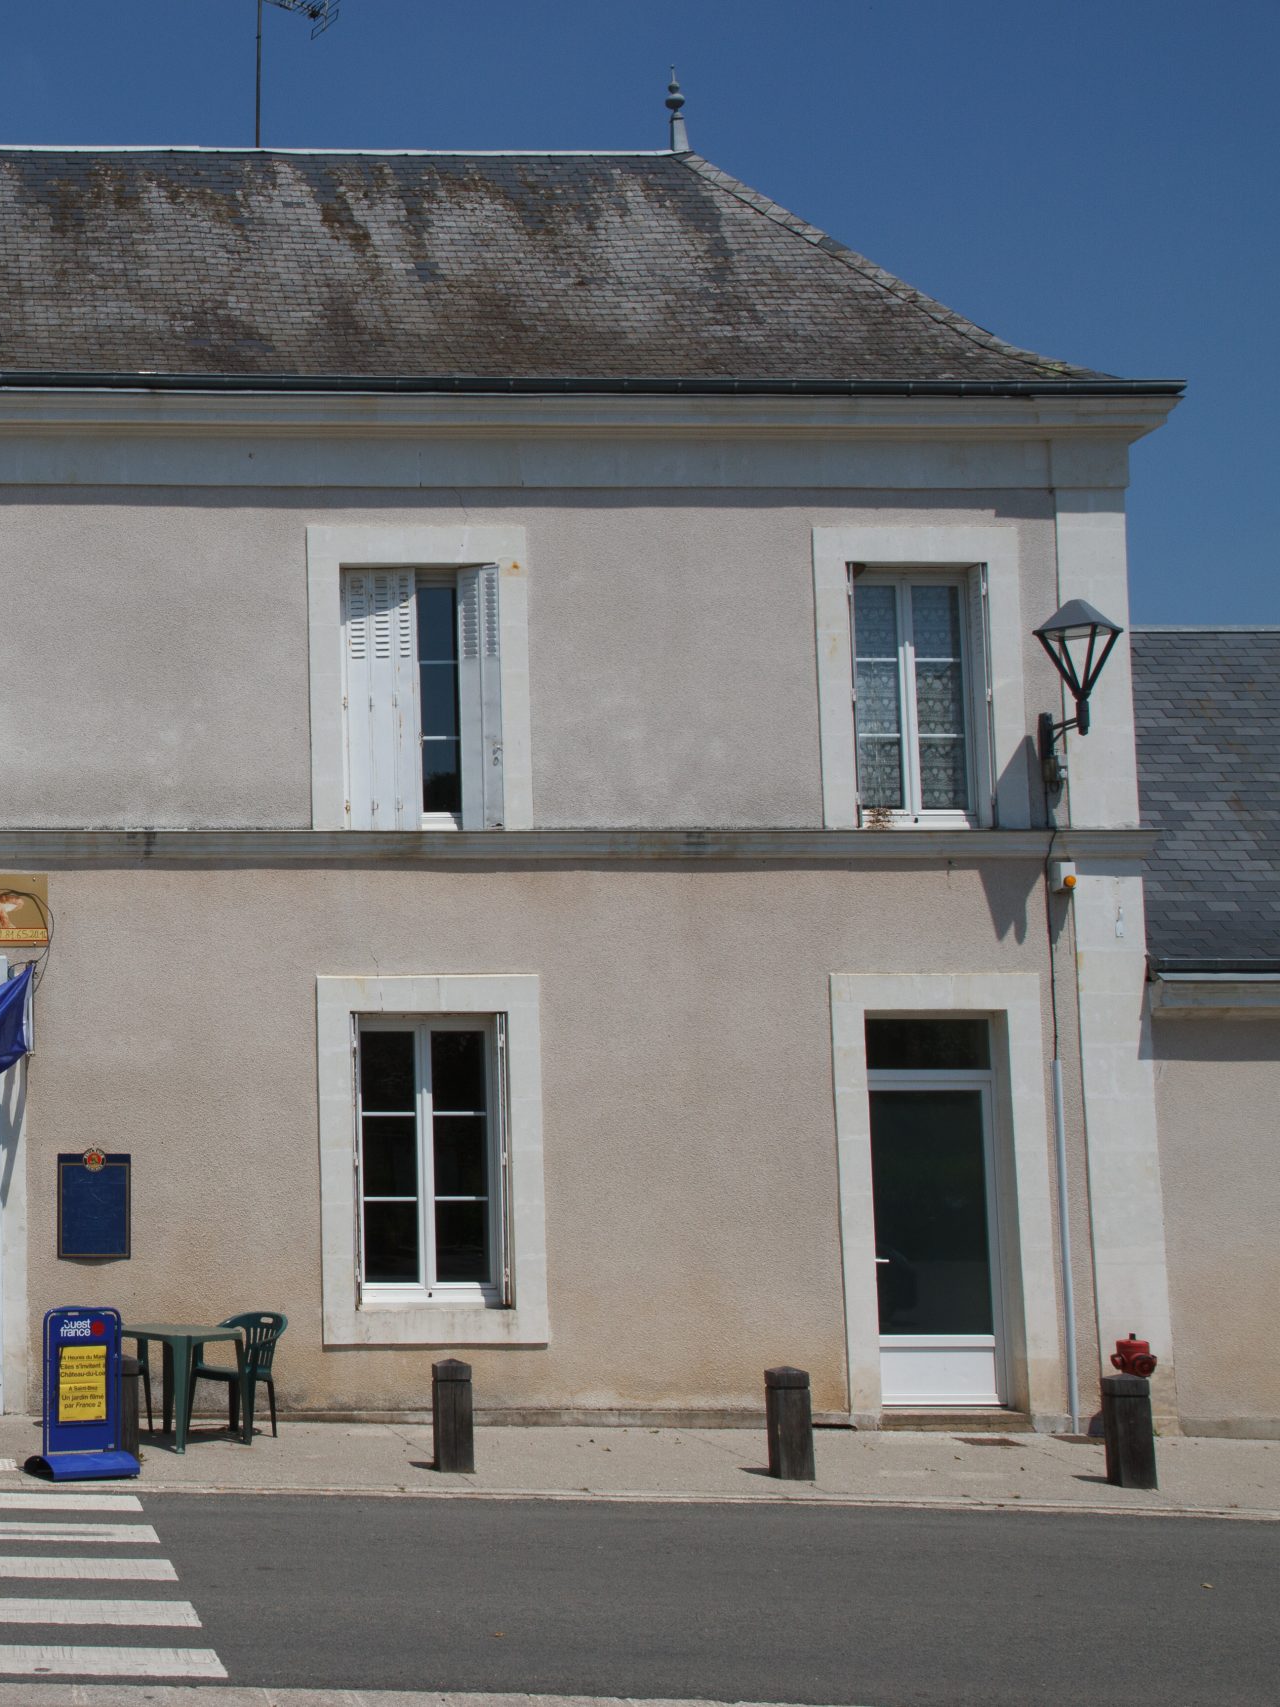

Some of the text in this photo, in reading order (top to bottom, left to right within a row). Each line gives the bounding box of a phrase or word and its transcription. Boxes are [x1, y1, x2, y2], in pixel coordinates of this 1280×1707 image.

[63, 1318, 91, 1329] Ouest
[60, 1327, 91, 1337] france
[71, 1393, 89, 1402] jardin
[64, 1402, 74, 1410] par
[75, 1401, 96, 1409] France
